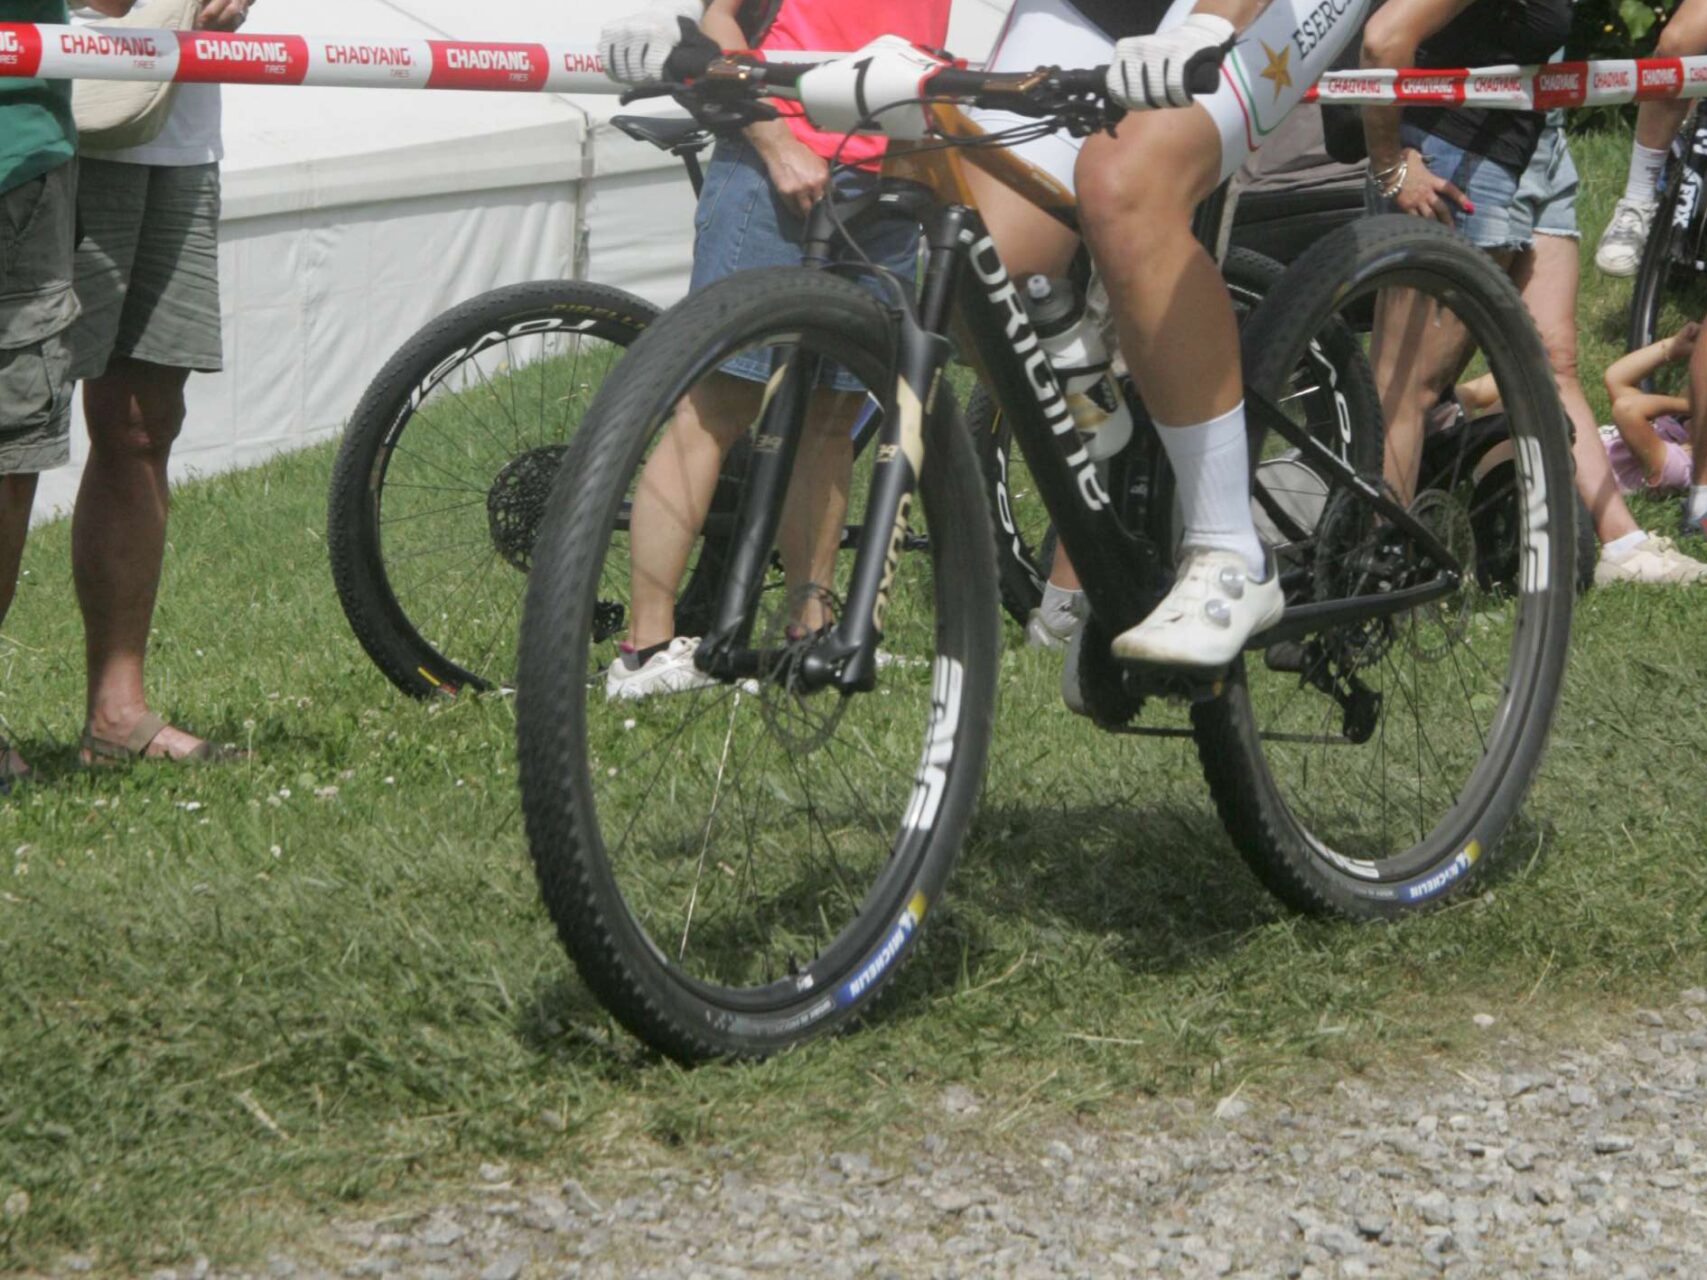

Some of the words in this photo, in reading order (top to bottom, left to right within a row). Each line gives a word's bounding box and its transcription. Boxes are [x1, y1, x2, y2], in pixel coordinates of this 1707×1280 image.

[60, 34, 157, 57] CHAOYANG
[195, 39, 288, 63] CHAOYANG
[324, 44, 412, 66] CHAOYANG
[446, 48, 530, 71] CHAOYANG
[564, 53, 605, 73] CHAO
[853, 56, 883, 131] 1
[1409, 863, 1458, 898] MICHELIN
[850, 930, 906, 997] MICHELIN
